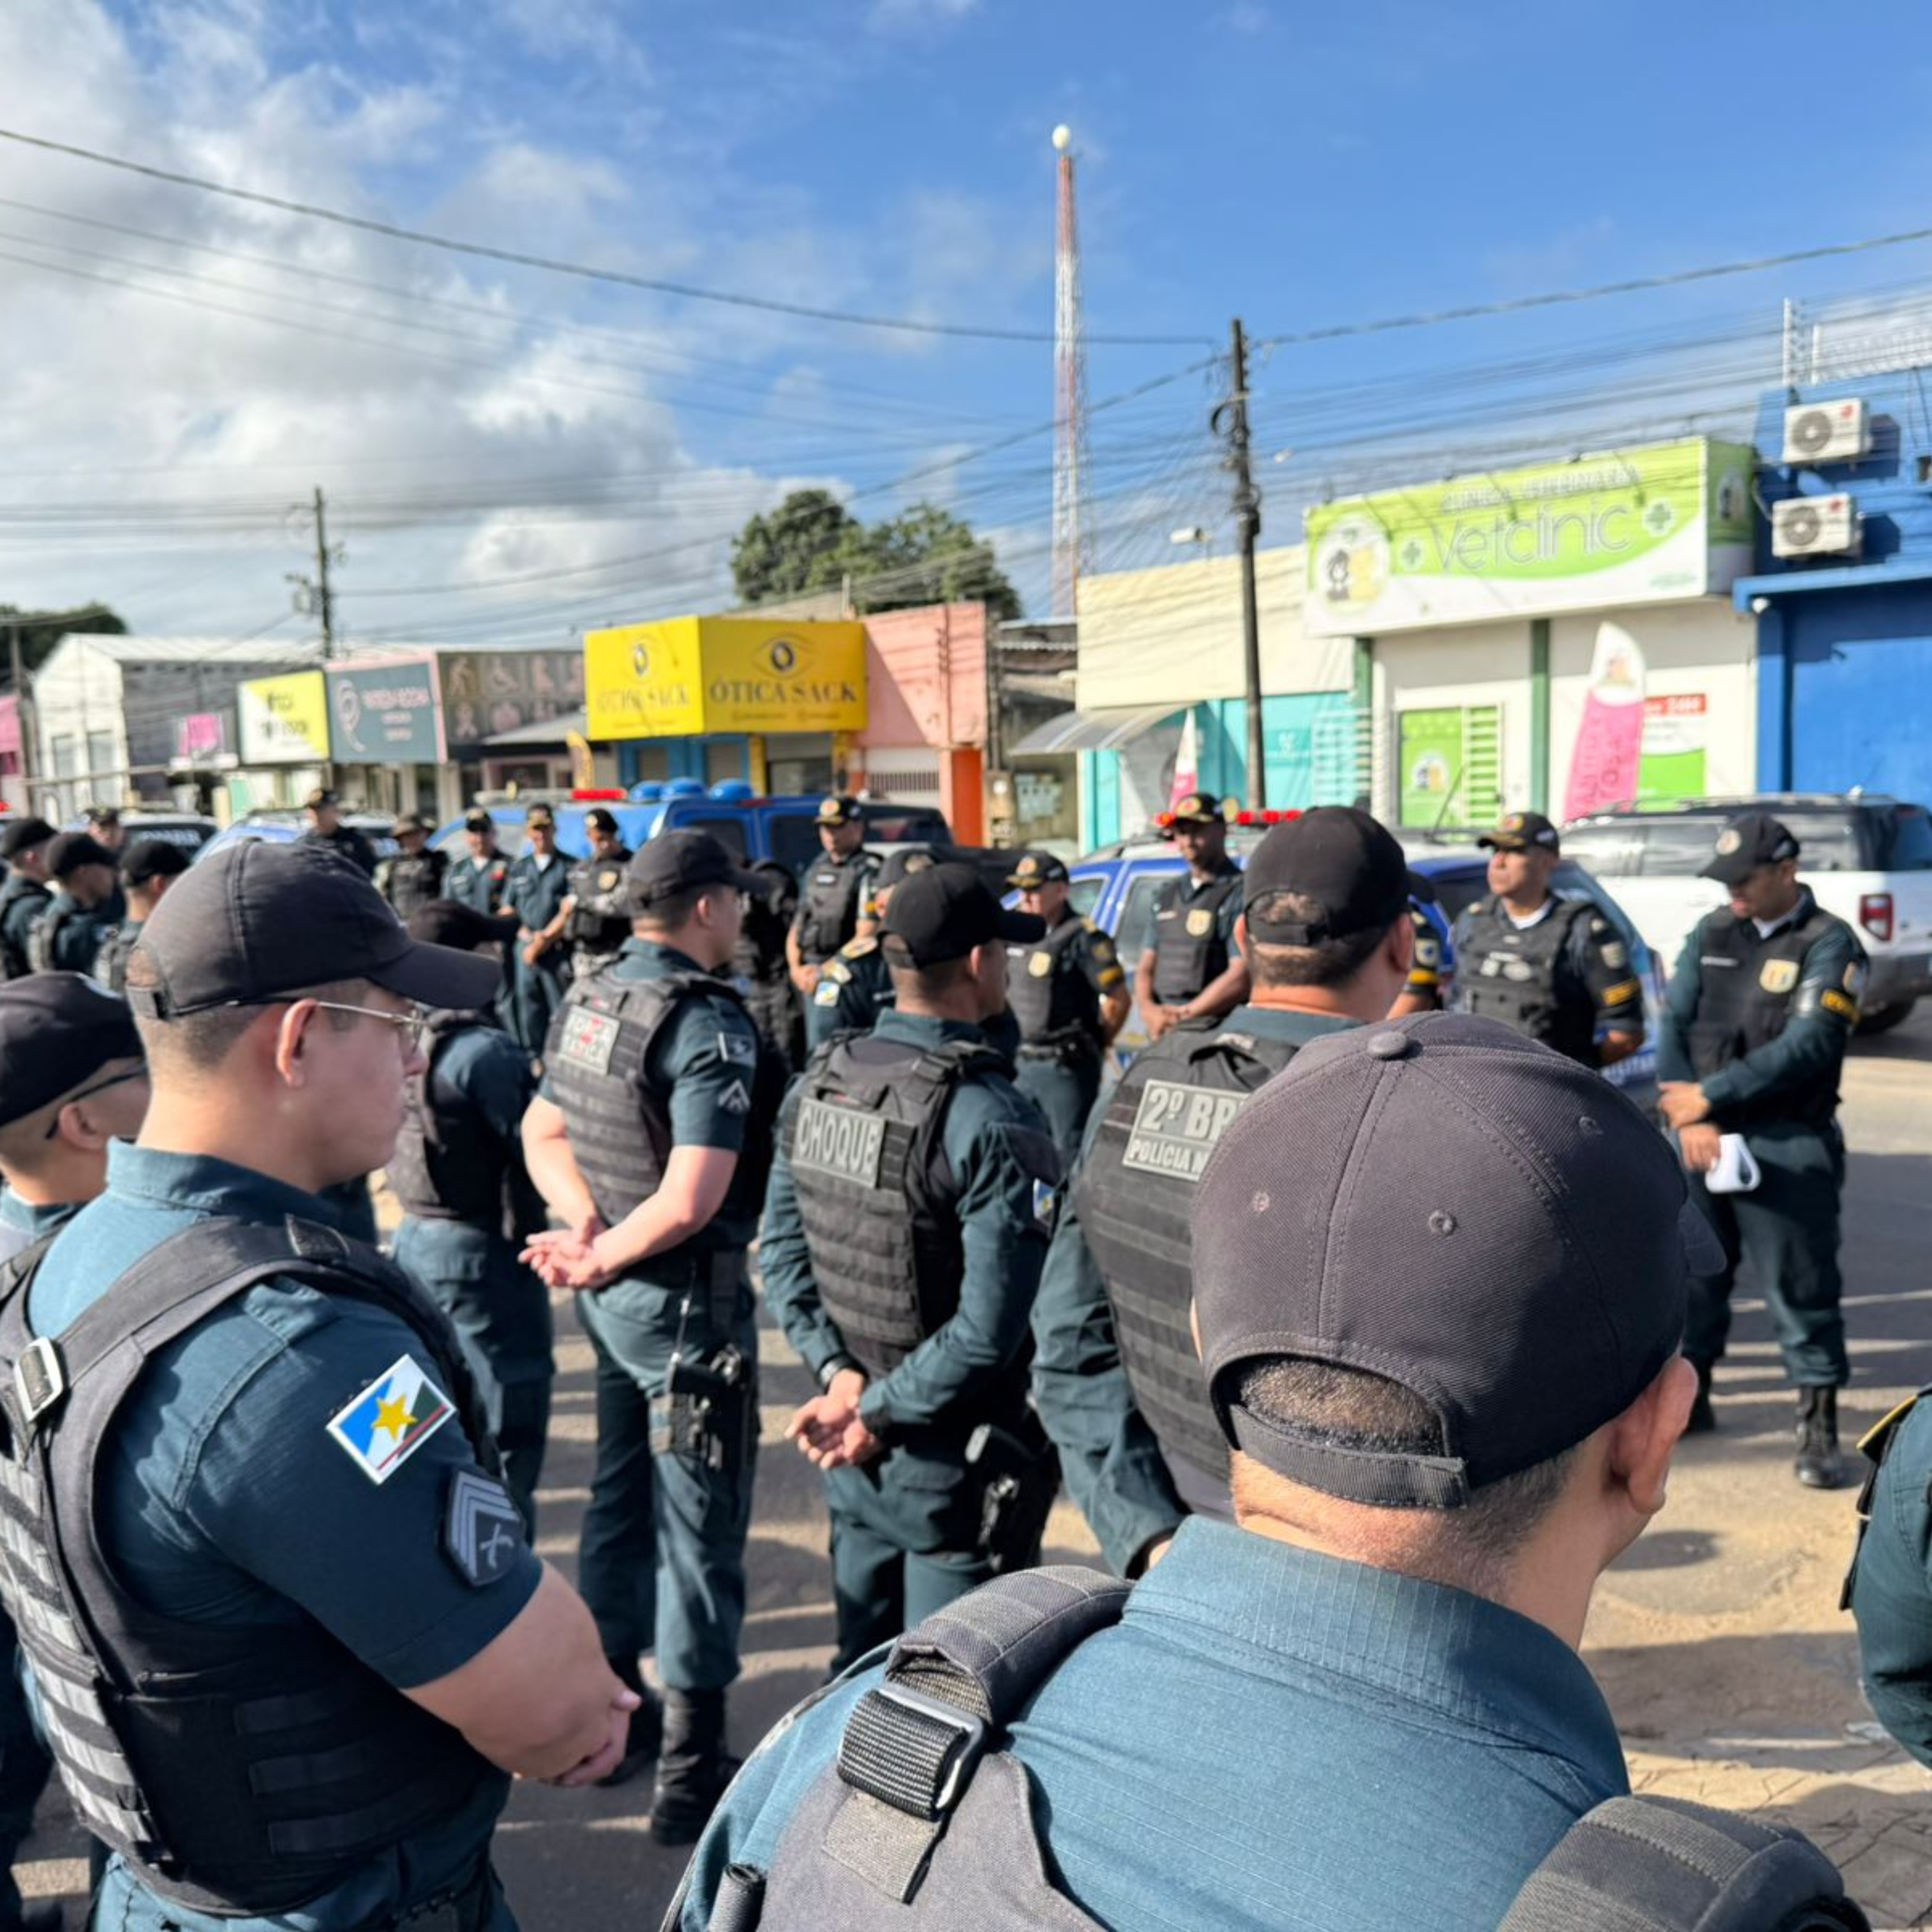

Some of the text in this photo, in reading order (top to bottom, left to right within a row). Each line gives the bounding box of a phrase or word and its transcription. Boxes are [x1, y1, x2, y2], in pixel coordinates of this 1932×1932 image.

[1430, 498, 1632, 573] Vetclinic
[710, 675, 857, 704] ÓTICA SACK
[799, 1106, 878, 1176] CHOQUE
[1184, 1093, 1246, 1141] BP
